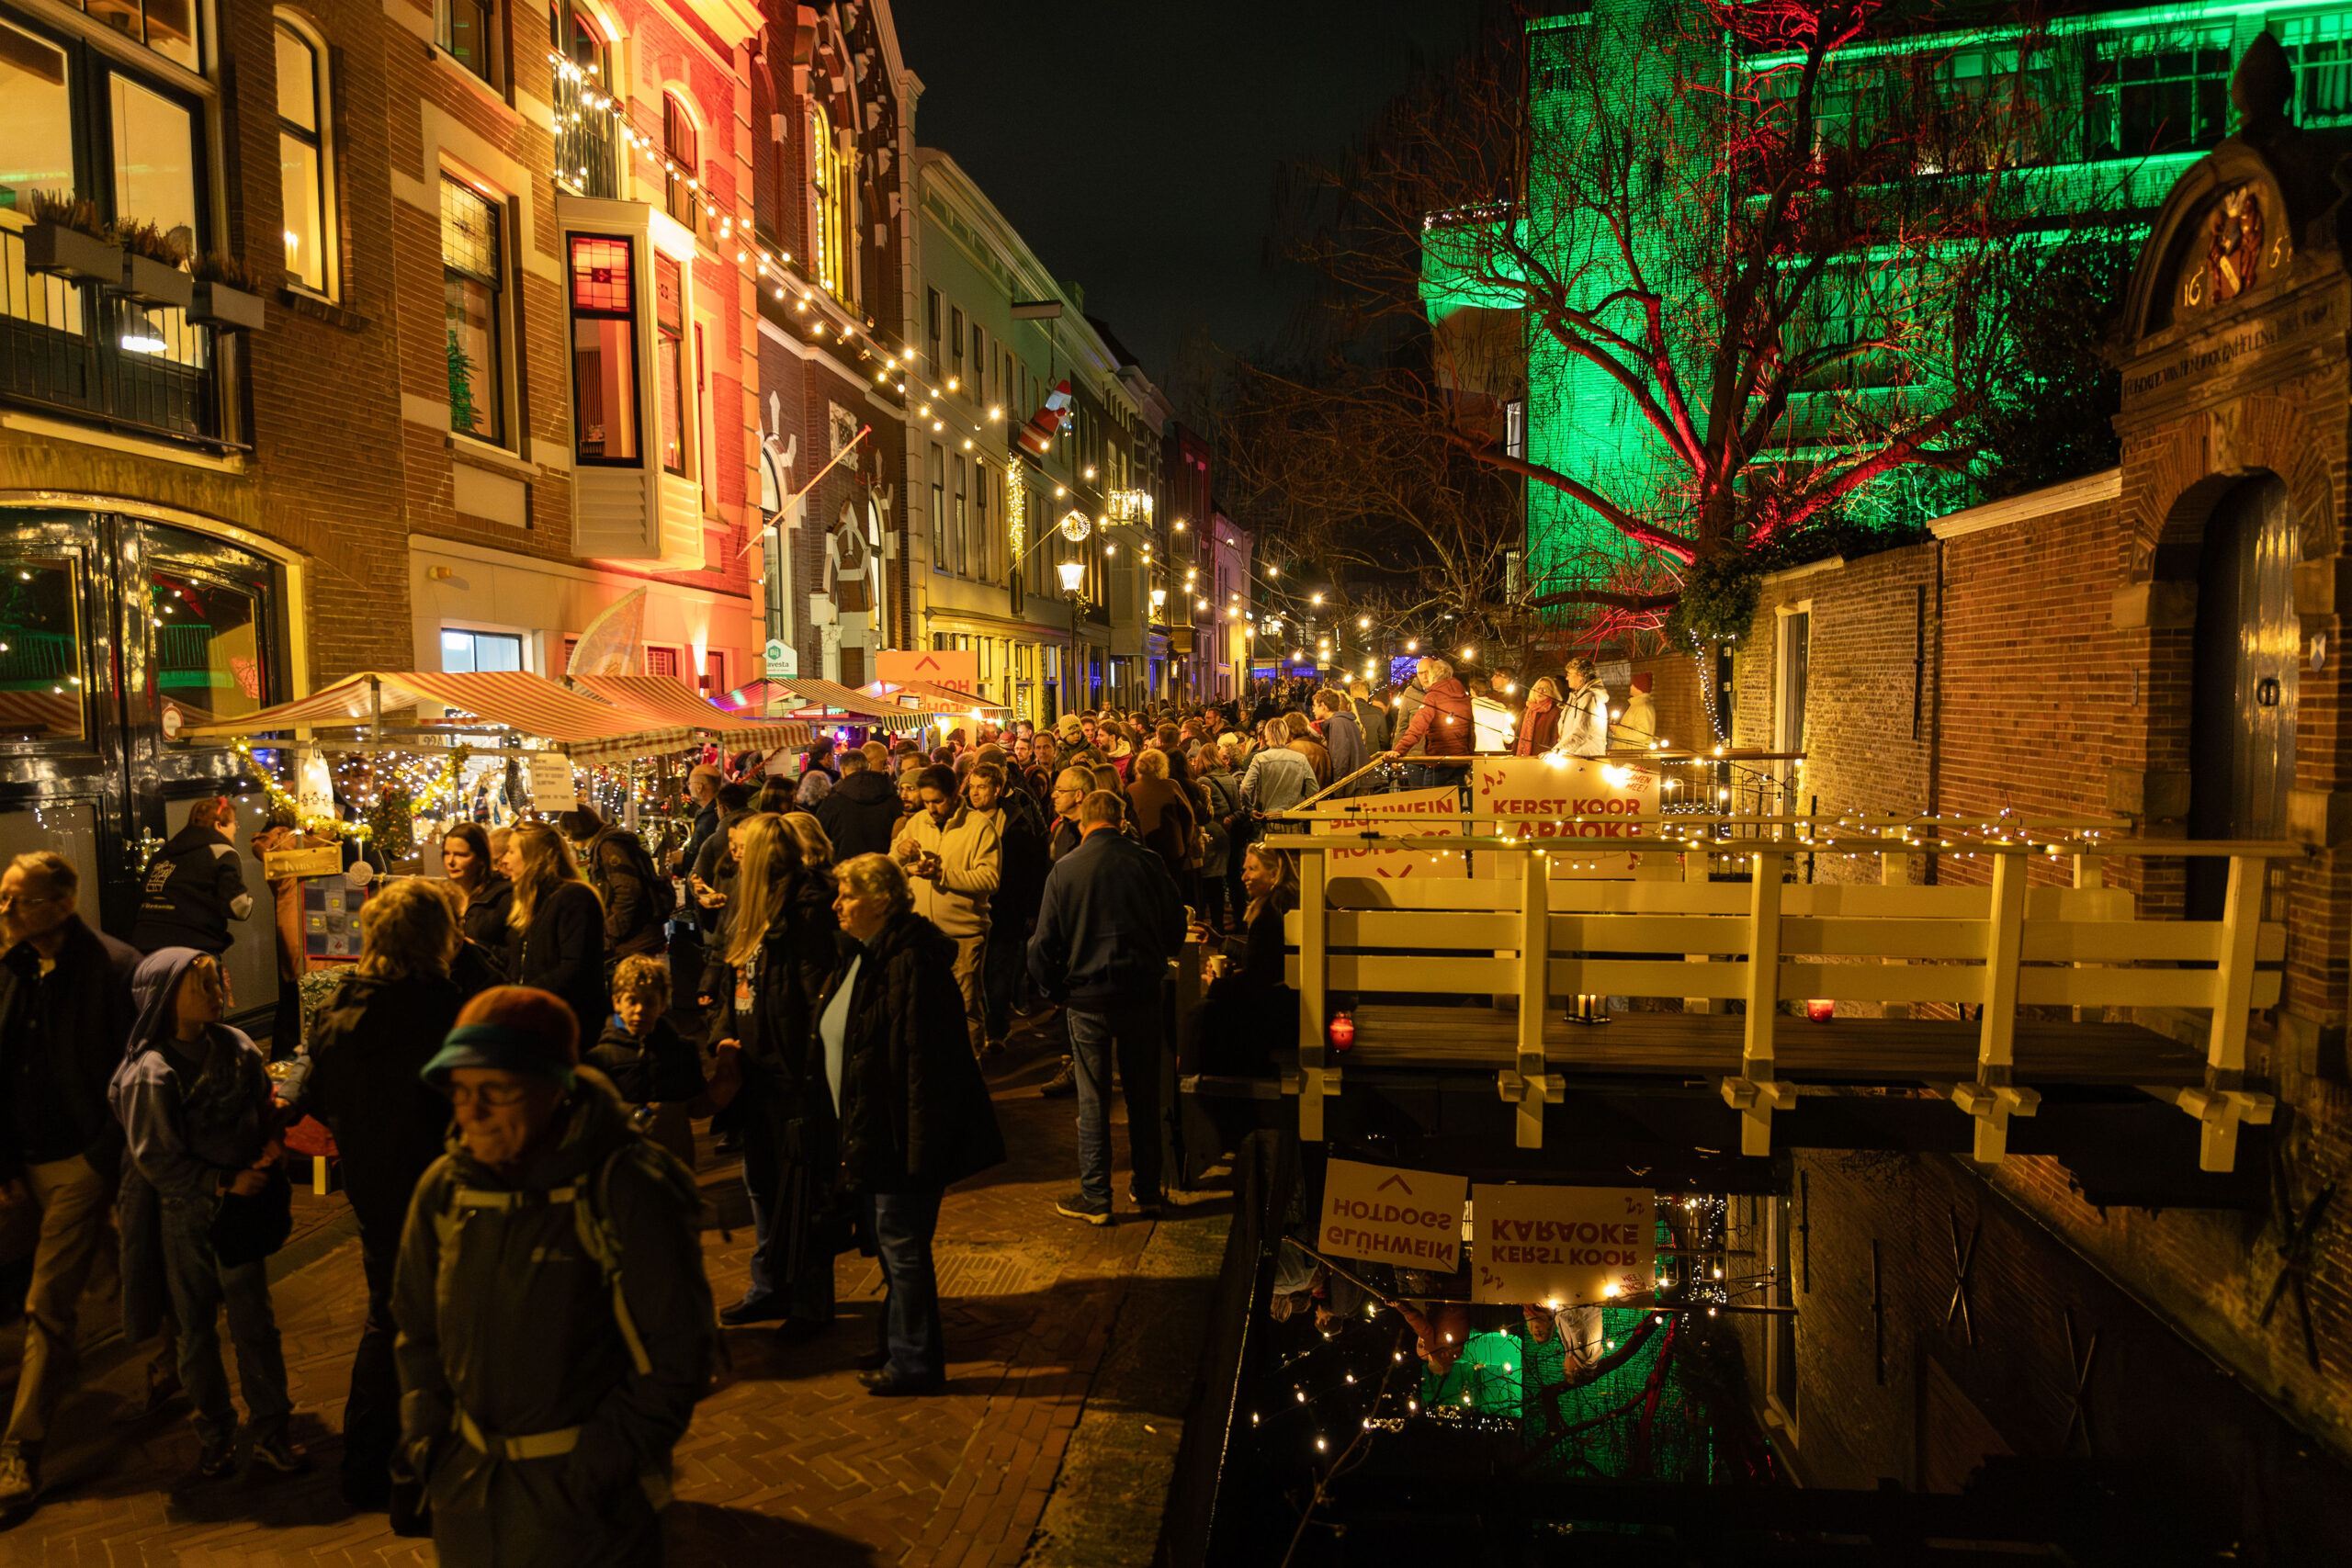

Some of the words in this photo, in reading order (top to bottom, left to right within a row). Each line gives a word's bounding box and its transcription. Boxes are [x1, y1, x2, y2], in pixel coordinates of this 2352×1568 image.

[2184, 265, 2204, 306] 16
[1493, 799, 1566, 815] KERST
[1573, 798, 1641, 816] KOOR
[1494, 821, 1643, 838] ARAOKE
